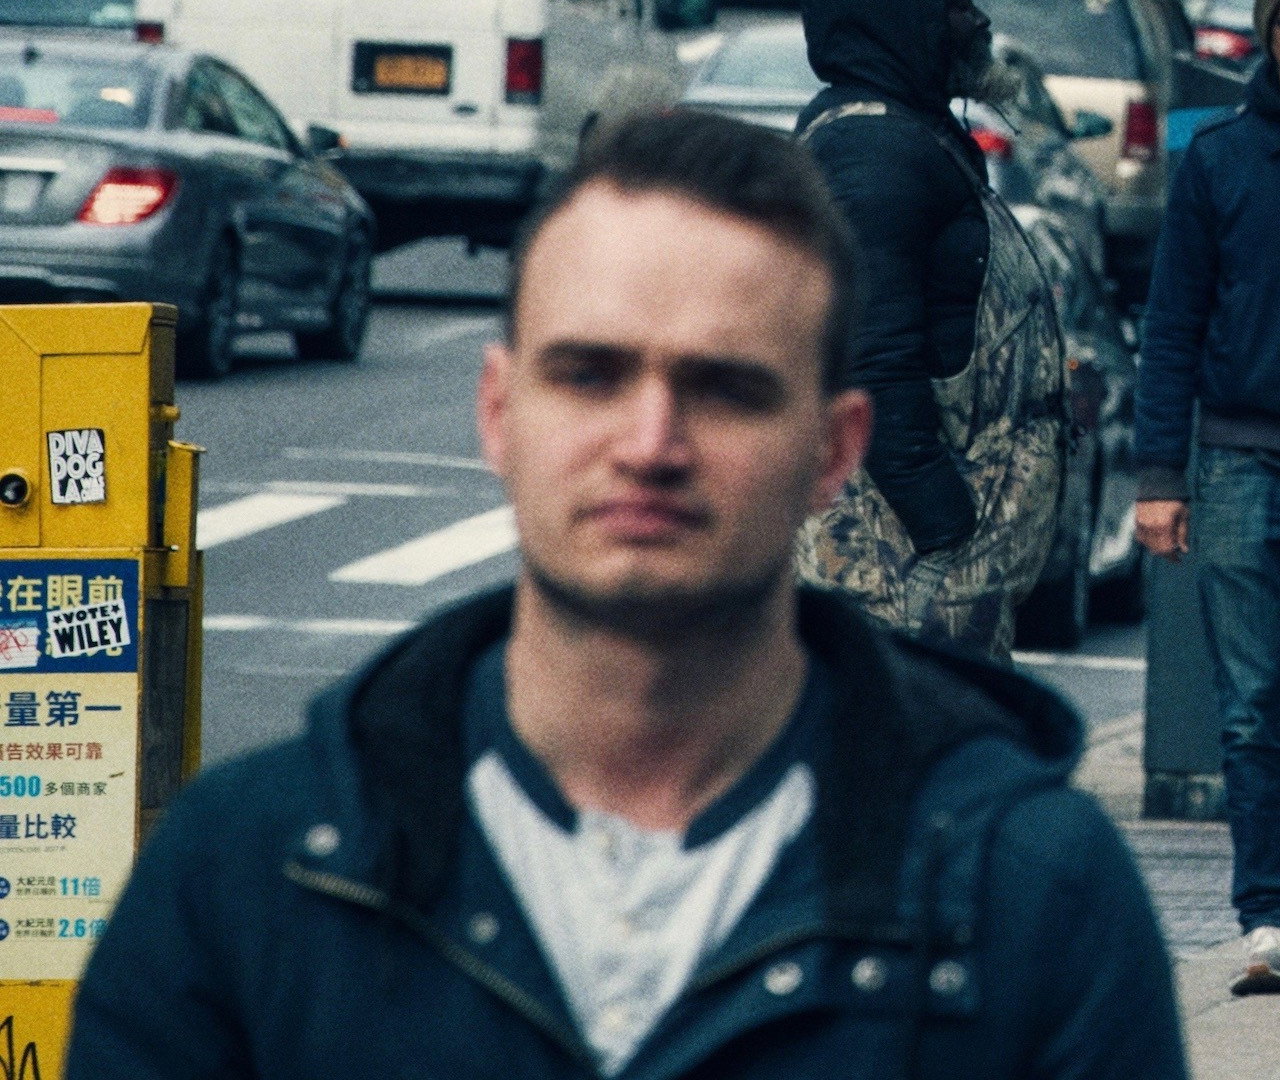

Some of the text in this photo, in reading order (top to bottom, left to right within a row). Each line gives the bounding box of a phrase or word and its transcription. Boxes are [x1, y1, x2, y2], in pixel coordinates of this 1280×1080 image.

[48, 429, 105, 457] DIVA
[50, 451, 105, 481] DOG
[51, 477, 83, 504] LA
[0, 573, 124, 613] 在眼前
[61, 605, 111, 624] VOTE
[54, 616, 123, 654] WILEY
